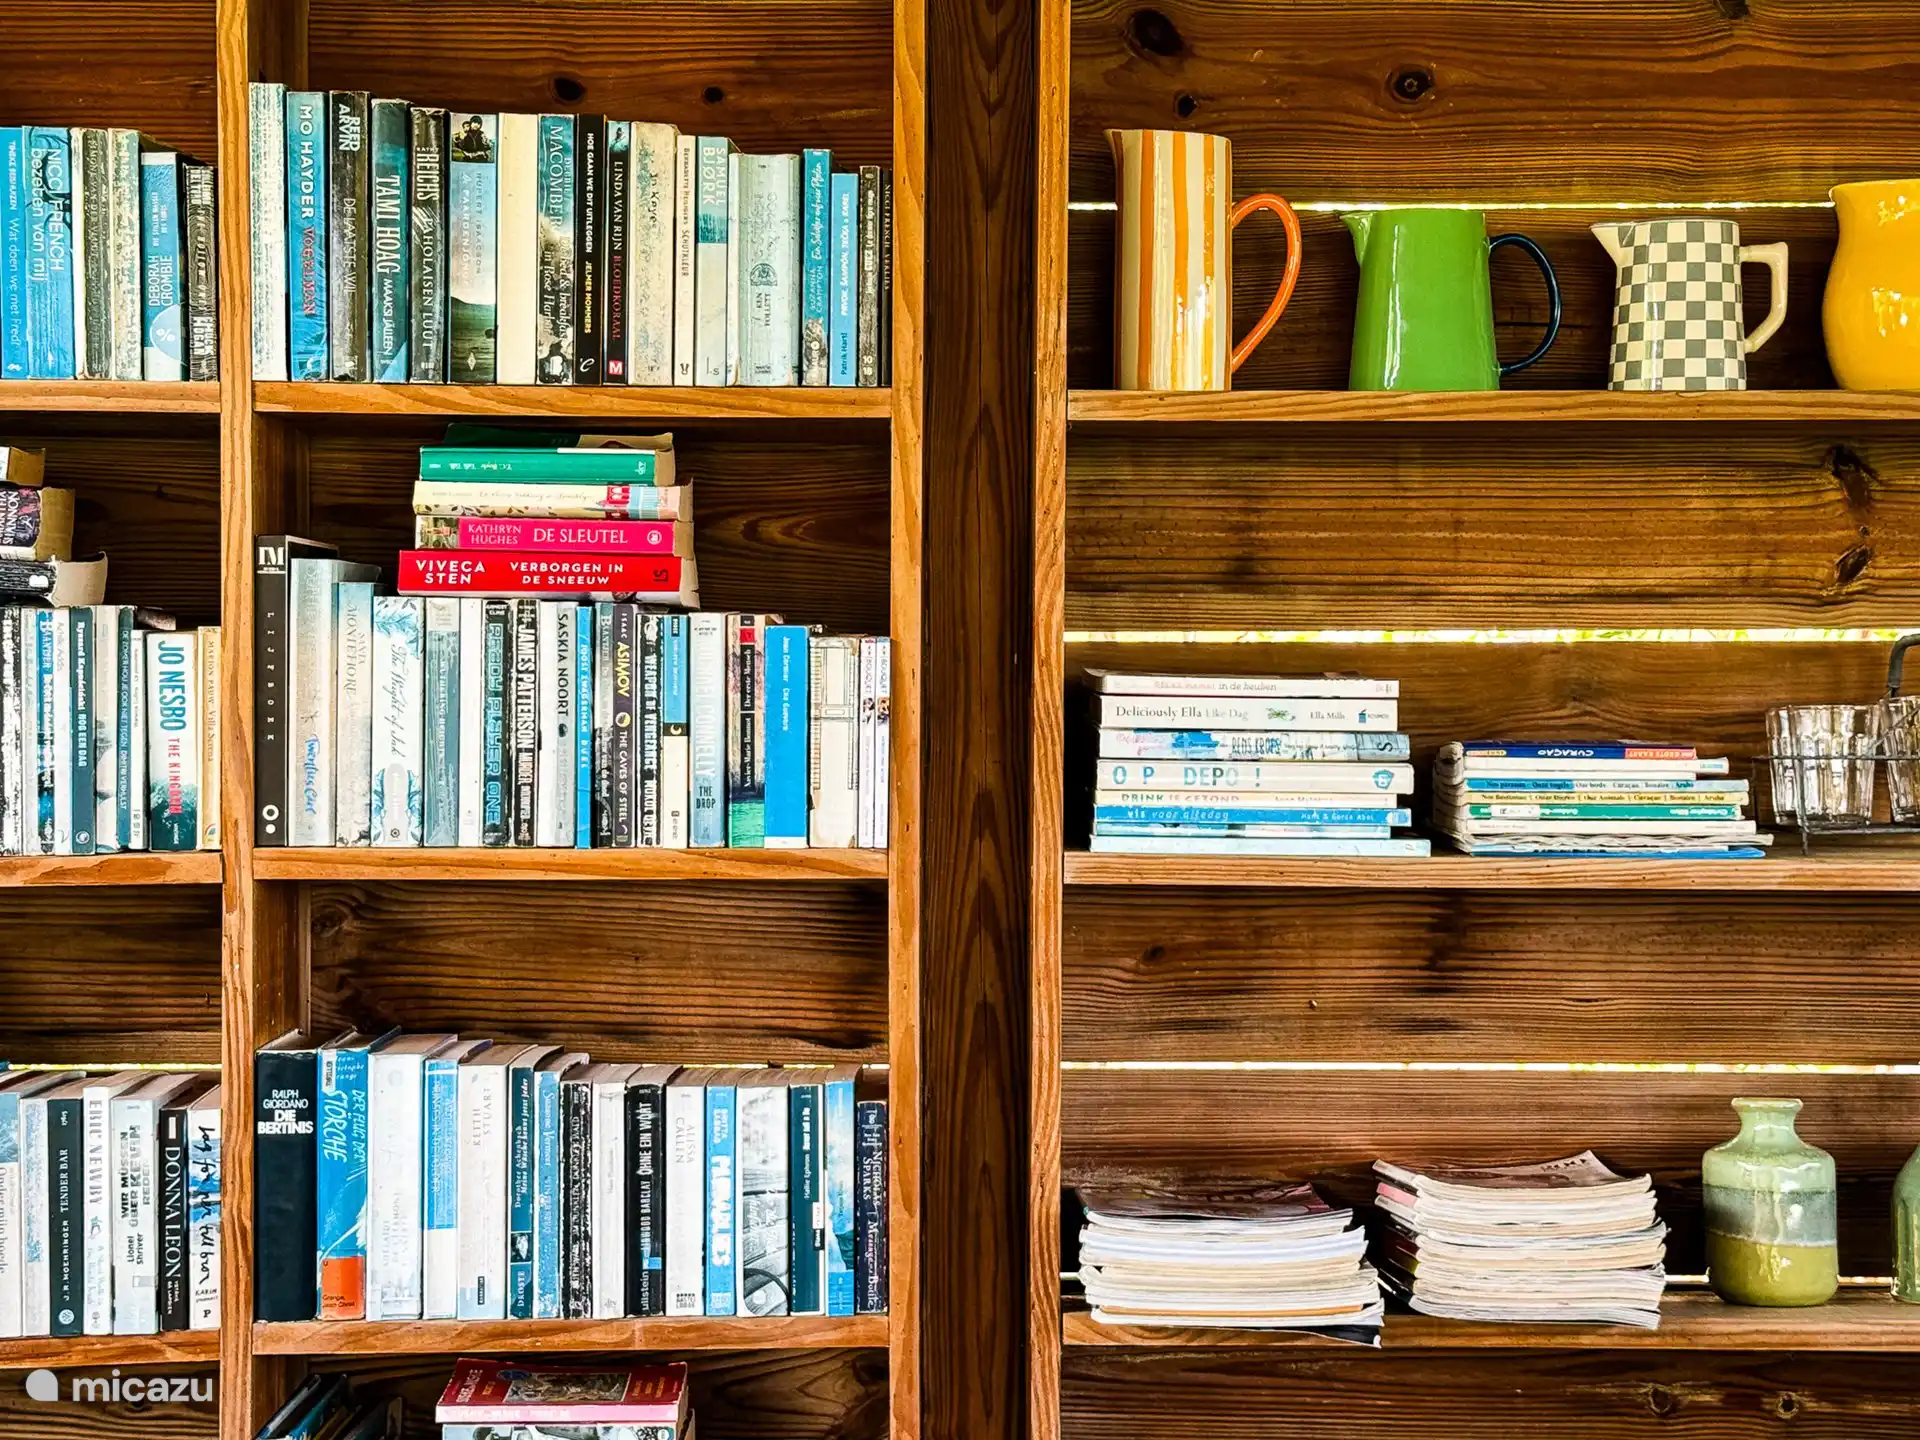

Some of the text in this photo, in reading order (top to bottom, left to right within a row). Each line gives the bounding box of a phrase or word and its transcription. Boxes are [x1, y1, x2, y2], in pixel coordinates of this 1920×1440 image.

[339, 104, 349, 150] ARVIN
[349, 117, 360, 151] REED
[300, 105, 314, 218] MO HAYDER
[549, 125, 564, 225] MACOMBER
[702, 146, 715, 205] BJØRK
[716, 146, 726, 206] SAMUEL
[586, 193, 594, 206] DIT
[587, 178, 594, 191] WE
[31, 148, 46, 281] bezeten van mij
[47, 148, 64, 270] NICCI FRENCH
[344, 198, 355, 214] DE
[376, 175, 401, 274] TAMI HOAG
[585, 208, 593, 253] UITLEGGEN
[9, 219, 19, 315] Wat doen we met
[416, 153, 439, 349] REICHS PAHOLAISEN LUUT
[612, 161, 623, 340] LINDA VAN RIJN BLOEDKORAAL
[148, 256, 159, 306] DEBORAH
[161, 256, 173, 306] CROMBIE
[543, 251, 555, 290] in Rose
[559, 256, 571, 288] bed &
[585, 261, 593, 291] JELMER
[840, 332, 848, 351] Hartl
[468, 524, 522, 534] KATHRYN
[472, 534, 518, 545] HUGHES
[534, 528, 628, 544] DE SLEUTEL
[416, 560, 486, 572] VIVECA
[424, 572, 472, 584] STEN
[510, 562, 623, 573] VERBORGEN IN
[522, 574, 610, 585] DE SNEEUW
[122, 631, 129, 640] DE
[344, 603, 357, 697] MONTEFIORE
[557, 614, 569, 717] SASKIA NOORT
[580, 644, 588, 671] JOOST
[615, 641, 630, 698] ASIMOV
[122, 683, 129, 691] JE
[517, 624, 535, 748] JAMES PATTERSON
[158, 641, 186, 814] JO NESBO THE KINGDOM
[207, 710, 216, 731] Villa
[487, 623, 503, 824] READY PLAYER ONE
[644, 654, 657, 770] WEAPON OF VENGEANCE
[1116, 706, 1248, 721] Deliciously Ella Dag
[78, 714, 87, 767] NOG EEN DAG
[207, 734, 215, 762] Serena
[619, 730, 627, 748] THE
[695, 703, 715, 777] CONNELLY
[1537, 749, 1594, 757] CURAÇAO
[619, 751, 627, 779] CAVES
[619, 782, 627, 795] OF
[696, 786, 712, 797] THE
[696, 798, 716, 809] DROP
[619, 798, 628, 822] STEEL
[1128, 809, 1146, 818] vis
[1152, 810, 1179, 818] voor
[263, 1099, 308, 1109] GIORDANO
[272, 1089, 299, 1099] RALPH
[484, 1088, 492, 1135] STUART
[543, 1090, 554, 1129] Suzanne
[257, 1122, 313, 1134] BERTINIS
[275, 1110, 296, 1121] DIE
[322, 1090, 352, 1163] STÖRCHE
[352, 1090, 365, 1138] DER FLUG
[473, 1109, 481, 1146] KEITH
[89, 1100, 101, 1205] ERIC NEWBY
[543, 1131, 555, 1166] Vermeer
[676, 1117, 685, 1164] CALLEN
[686, 1124, 696, 1164] ALISSA
[60, 1149, 69, 1212] TENDER BAR
[119, 1131, 129, 1218] WIR MÜSSEN
[129, 1125, 140, 1227] ÜBER KEVIN
[803, 1154, 812, 1178] Ephron
[863, 1157, 872, 1200] SPARKS
[872, 1151, 882, 1206] NICHOLAS
[165, 1146, 181, 1278] DONNA LEON
[638, 1102, 652, 1310] ullstein BARCLAY OHNE EIN WORT
[135, 1233, 144, 1265] Shriver
[199, 1224, 212, 1247] till
[866, 1221, 878, 1309] Message Bottle
[517, 1271, 525, 1307] DROSTE
